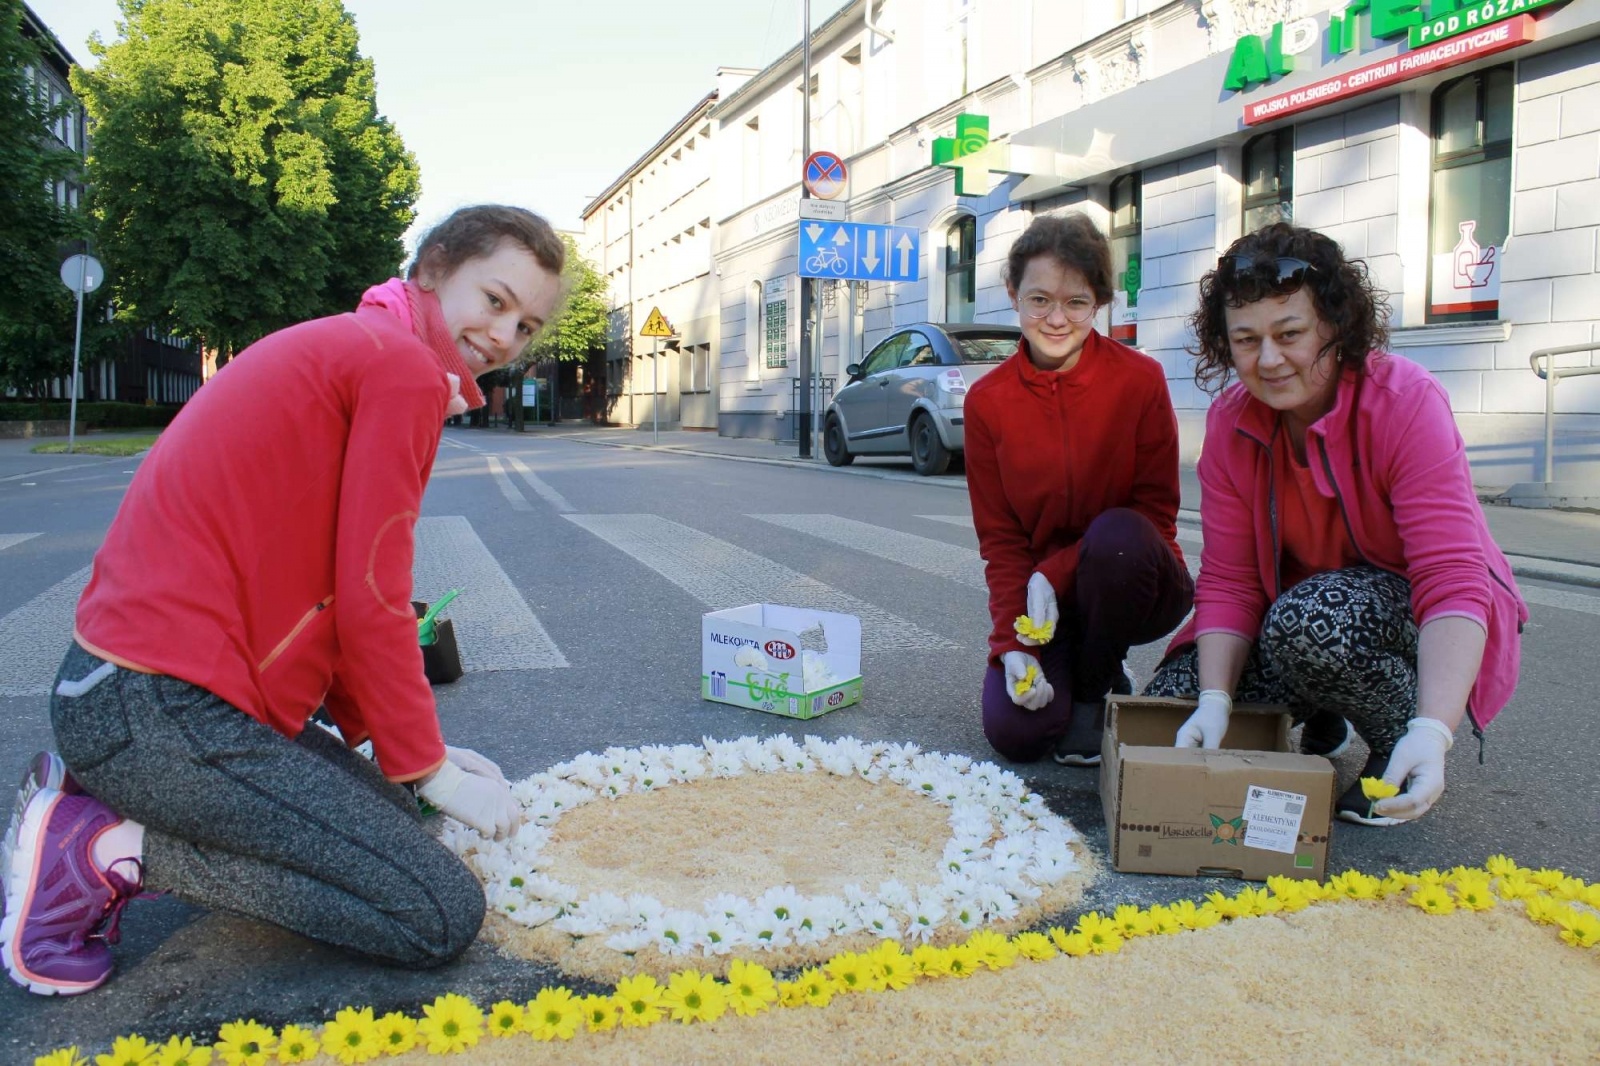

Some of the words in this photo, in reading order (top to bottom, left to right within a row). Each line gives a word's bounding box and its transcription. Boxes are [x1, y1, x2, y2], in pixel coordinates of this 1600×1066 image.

[1420, 16, 1459, 41] POD
[1253, 96, 1289, 118] WOJSKA
[1289, 80, 1341, 106] POLSKIEGO
[1348, 62, 1398, 88] CENTRUM
[1400, 25, 1510, 72] FARMACEUTYCZNE
[710, 632, 760, 651] MLEKOVITA
[1252, 812, 1297, 828] KLEMENTYNKI
